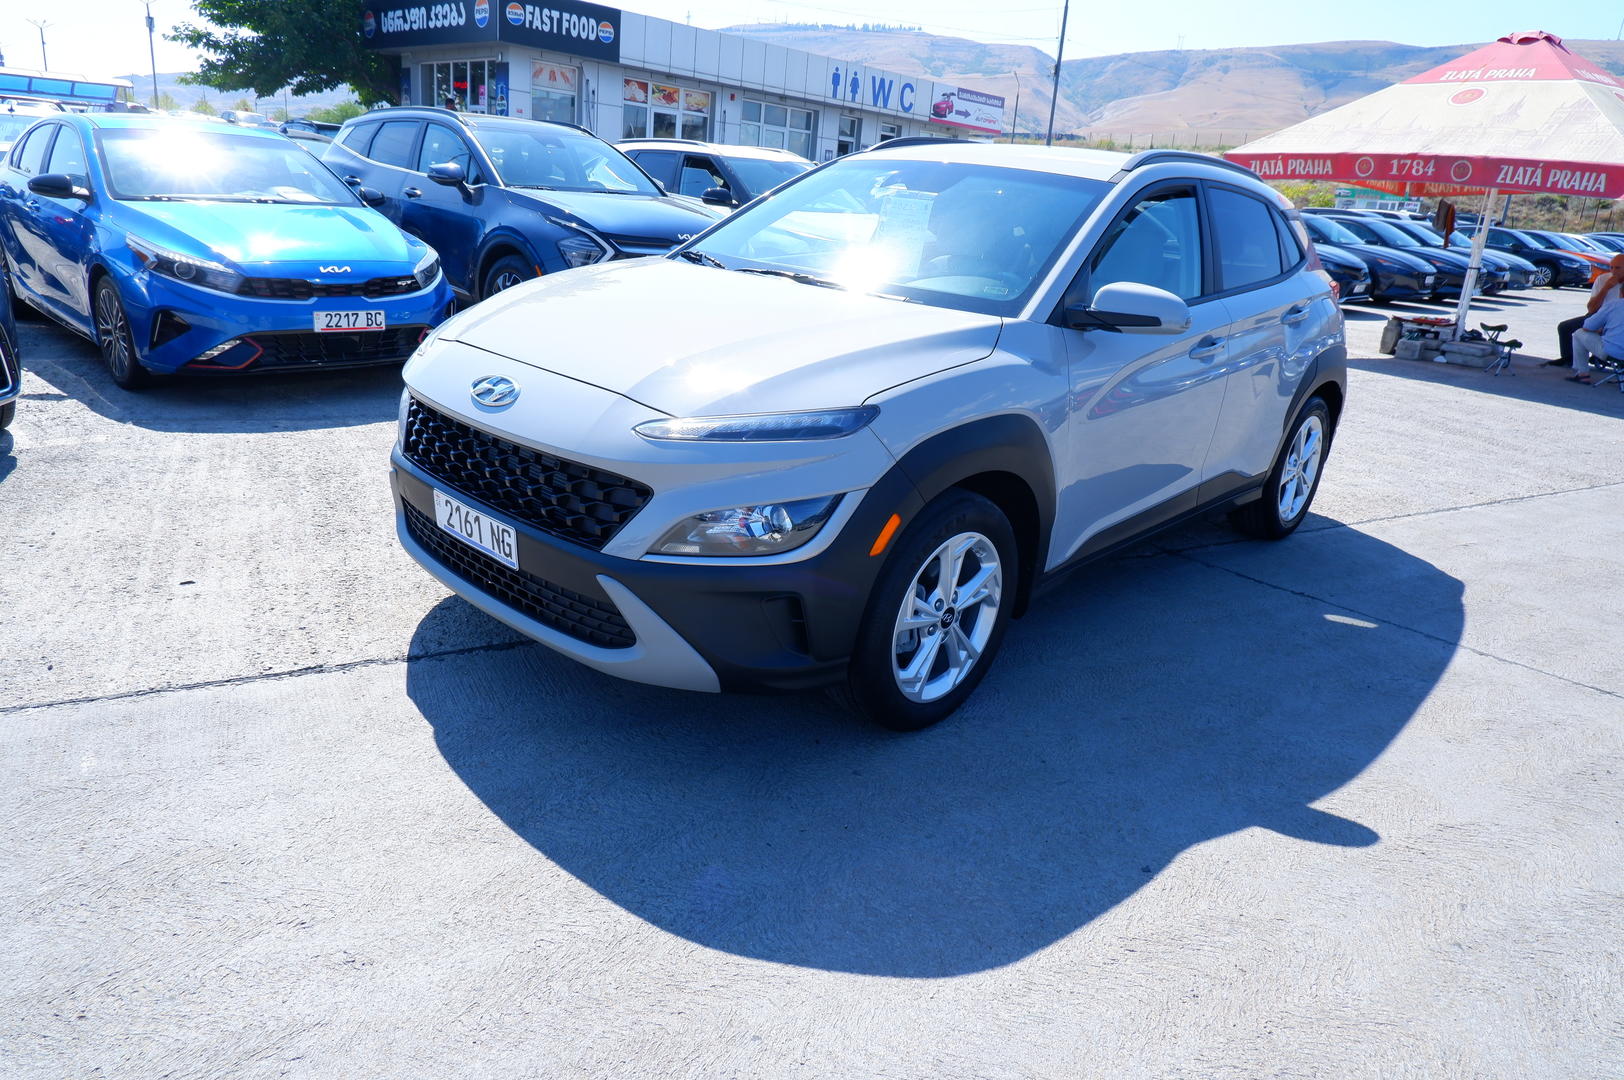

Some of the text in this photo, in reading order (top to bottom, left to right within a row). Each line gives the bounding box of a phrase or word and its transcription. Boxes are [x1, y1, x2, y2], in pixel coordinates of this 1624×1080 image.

[428, 2, 467, 29] კვება
[525, 5, 597, 41] FAST FOOD
[1440, 68, 1536, 80] ZLATÁ PRAHA
[1287, 159, 1333, 175] PRAHA
[1389, 159, 1435, 176] 1784
[1497, 163, 1607, 193] ZLATÁ PRAHA
[325, 312, 383, 328] 2217 BC
[445, 499, 513, 560] 2161 NG
